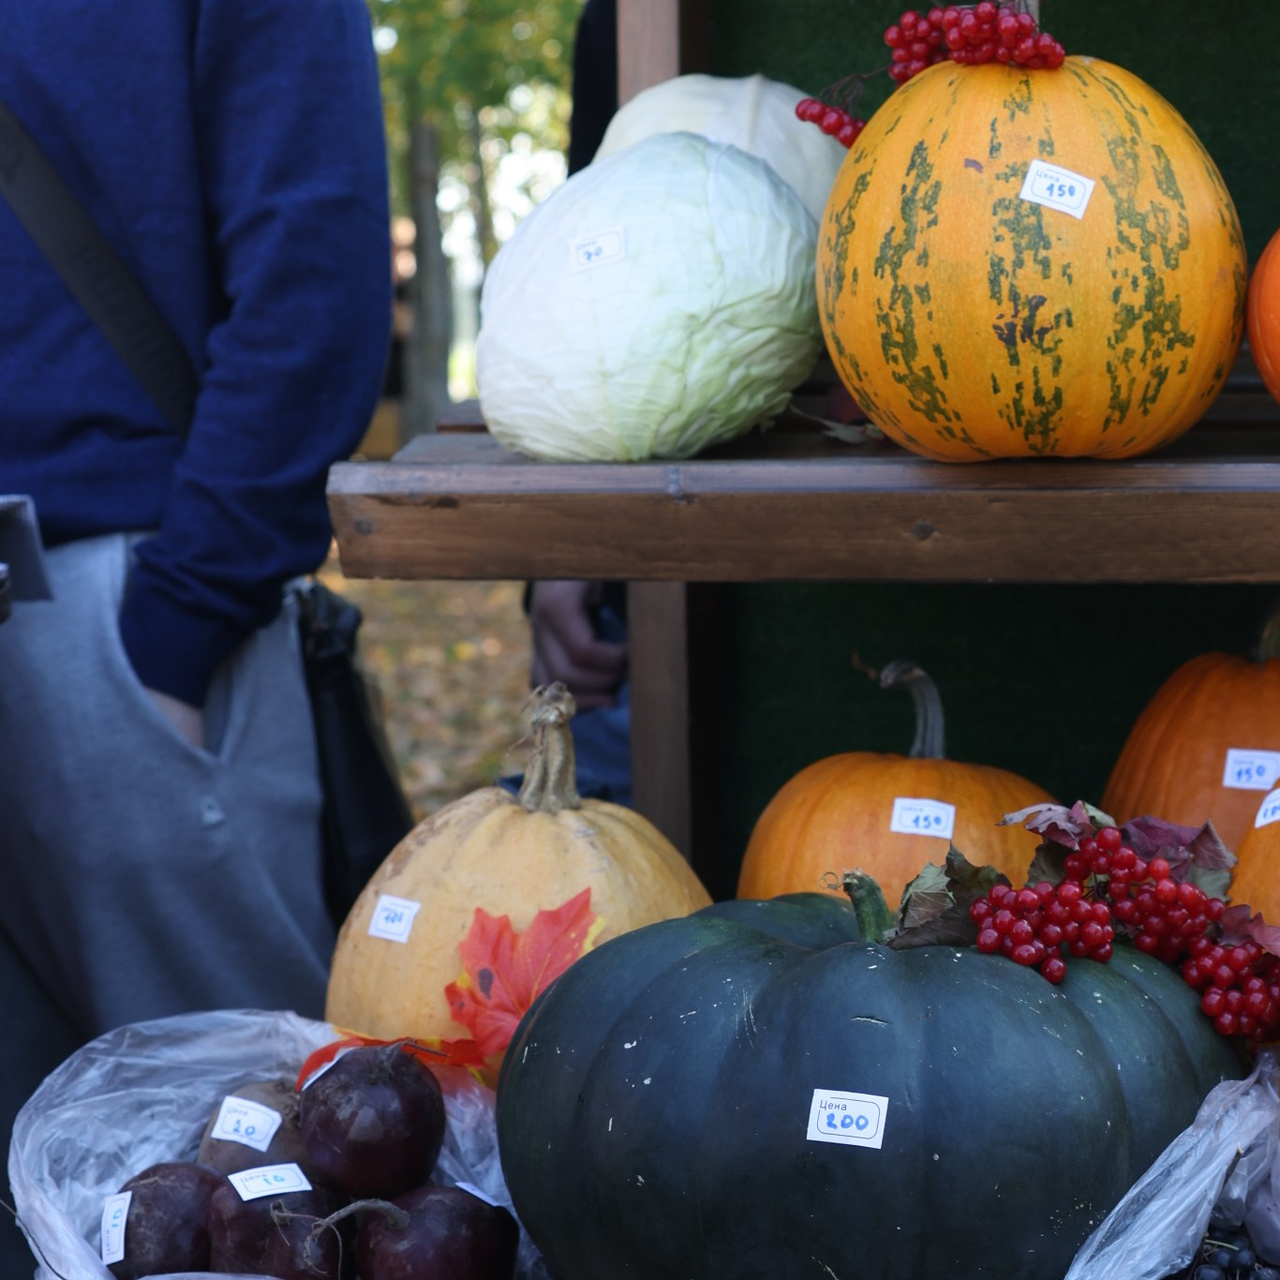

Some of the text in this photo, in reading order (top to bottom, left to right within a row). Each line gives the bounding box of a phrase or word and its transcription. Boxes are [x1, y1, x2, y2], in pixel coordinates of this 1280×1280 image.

[1036, 169, 1060, 182] Цена
[1046, 183, 1076, 197] 150
[1236, 765, 1266, 782] 150
[913, 815, 942, 829] 150
[820, 1100, 847, 1110] Цена
[263, 1175, 285, 1186] 10
